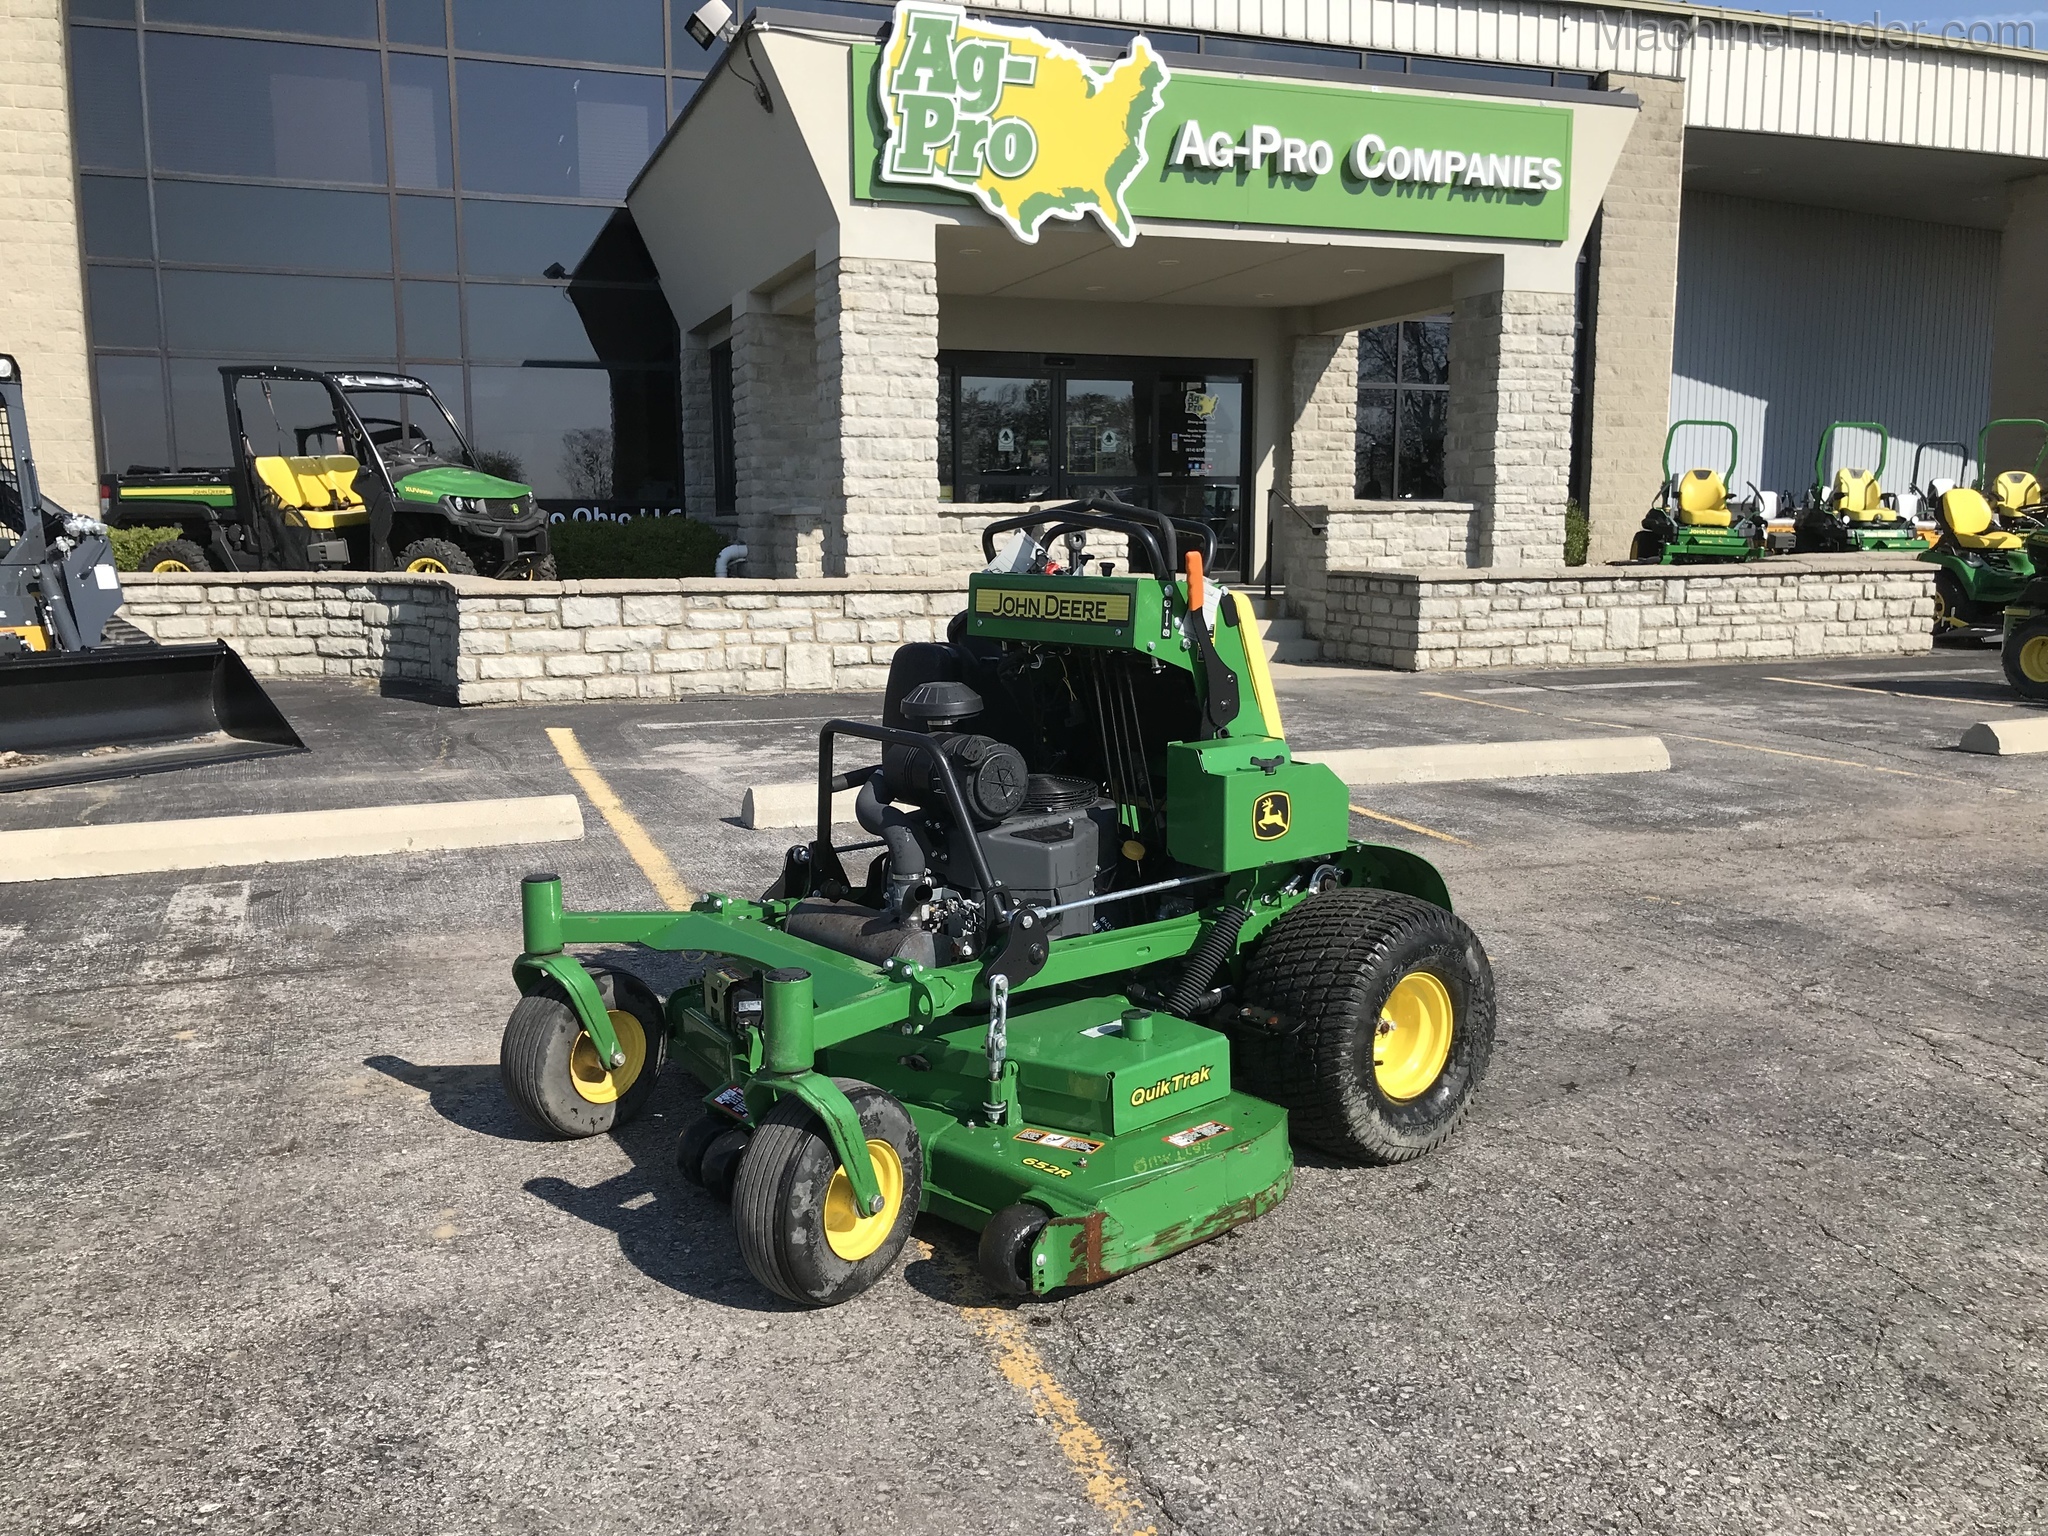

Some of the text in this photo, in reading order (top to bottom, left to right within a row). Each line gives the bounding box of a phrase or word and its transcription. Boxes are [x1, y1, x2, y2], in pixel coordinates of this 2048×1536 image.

[891, 10, 1037, 115] Ag-
[893, 94, 1038, 179] Pro
[1352, 133, 1563, 190] COMPANIES
[992, 592, 1108, 620] JOHN DEERE
[1022, 1157, 1074, 1179] 652R
